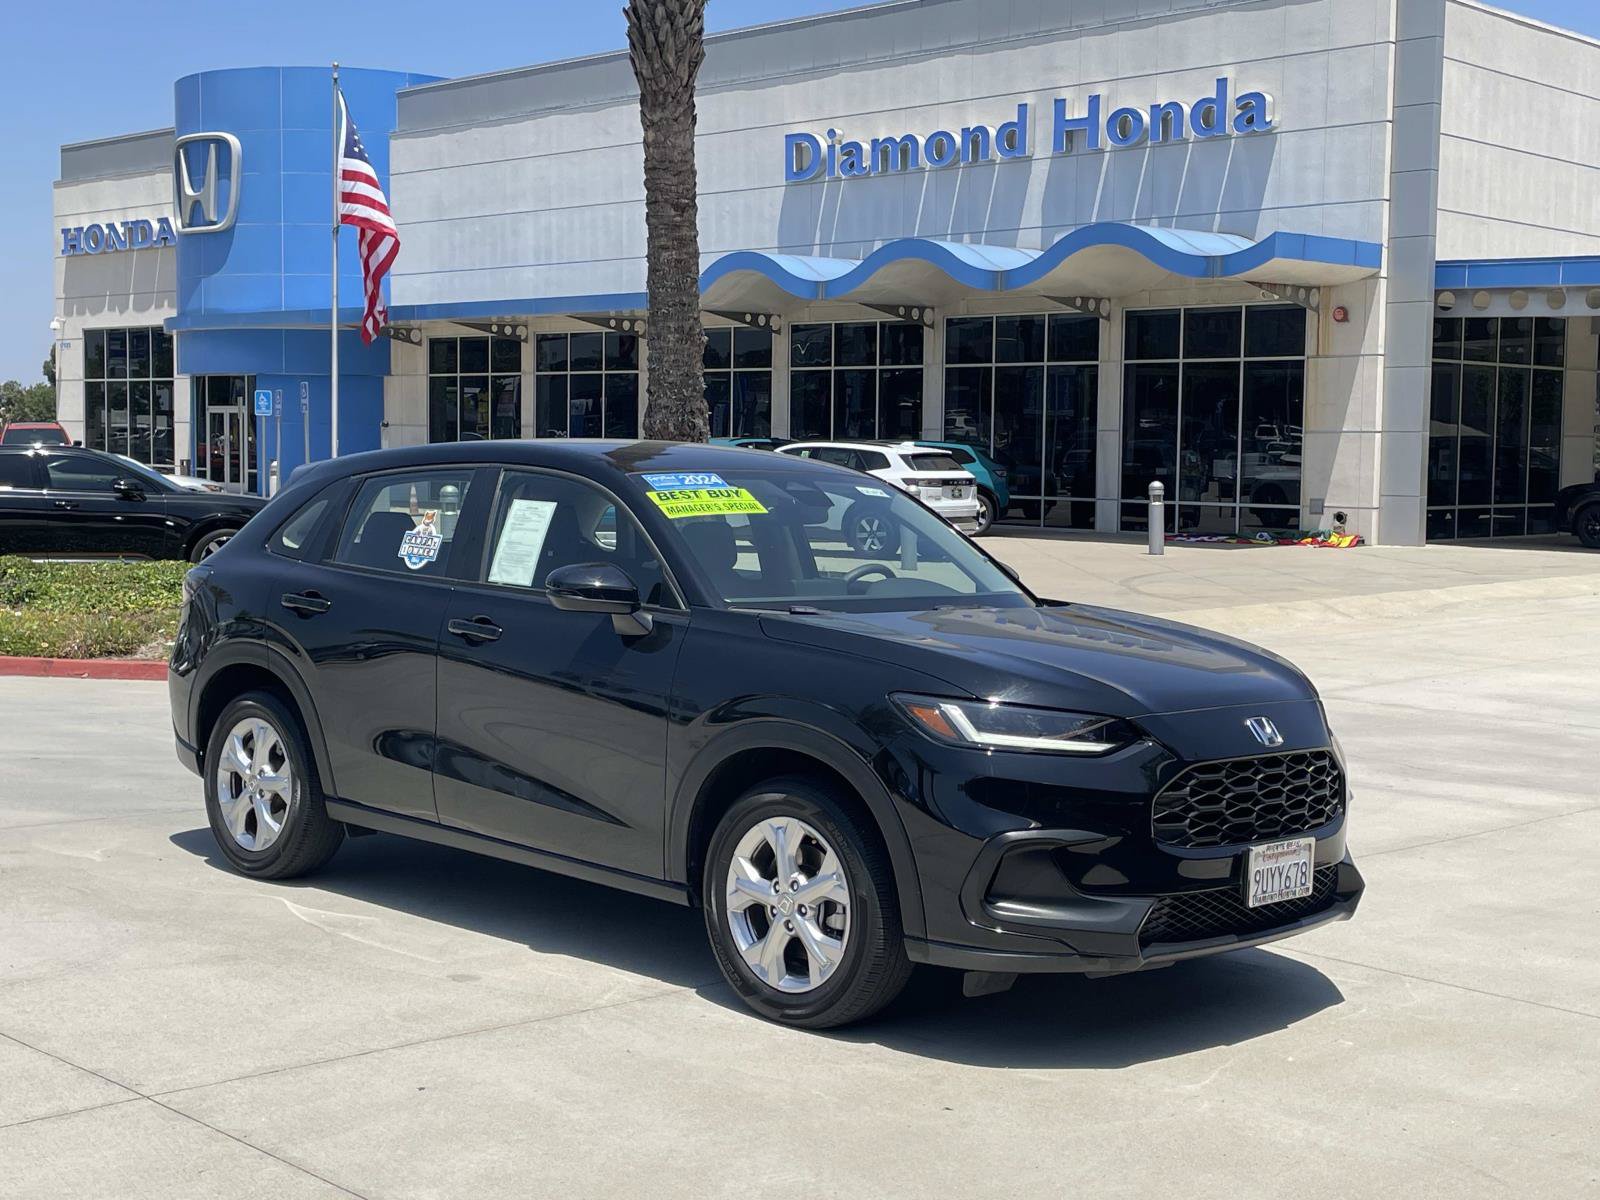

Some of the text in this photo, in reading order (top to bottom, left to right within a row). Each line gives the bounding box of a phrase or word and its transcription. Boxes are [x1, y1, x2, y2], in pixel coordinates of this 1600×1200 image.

[784, 77, 1276, 183] Diamond Honda
[61, 216, 176, 256] HONDA
[680, 475, 723, 485] 2024
[656, 489, 742, 501] BEST BUY
[666, 502, 761, 514] MANAGER'S SPECIAL
[405, 535, 439, 548] CARFAX
[1254, 861, 1308, 896] 9UYY678
